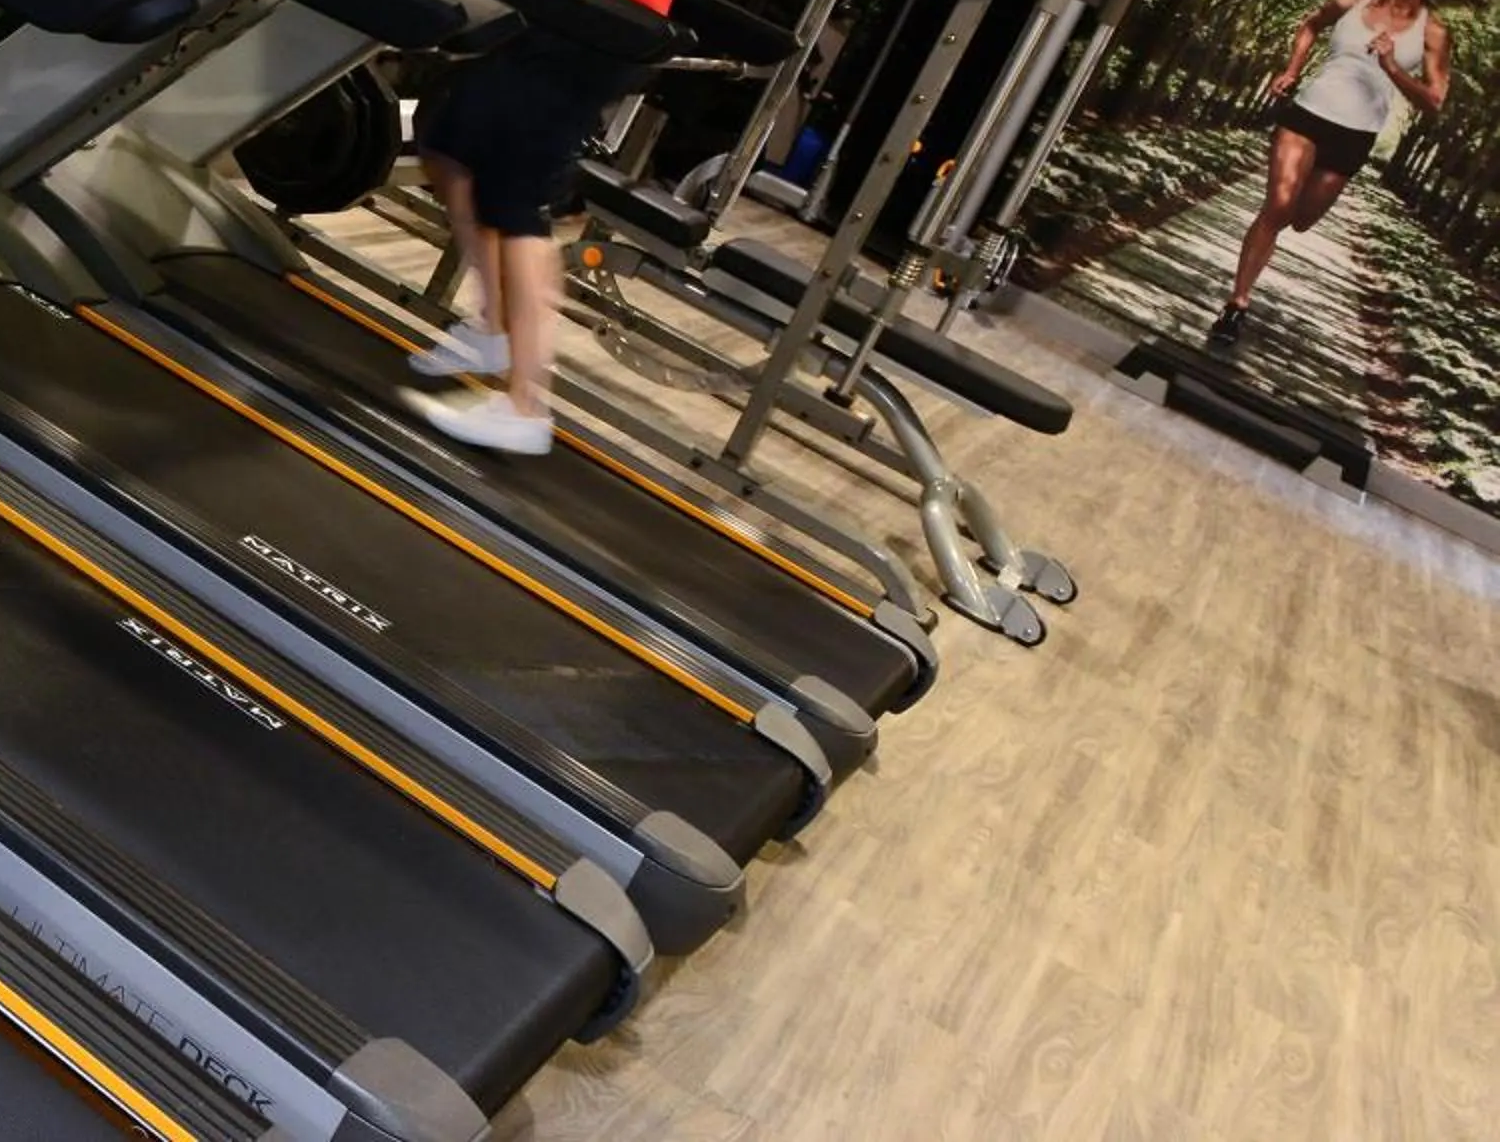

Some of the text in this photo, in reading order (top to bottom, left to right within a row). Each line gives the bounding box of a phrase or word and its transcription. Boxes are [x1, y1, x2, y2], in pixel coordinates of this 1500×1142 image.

[243, 535, 388, 631] MATRIX
[121, 618, 283, 729] MATRIX
[10, 905, 274, 1115] ULTIMATE DECK
